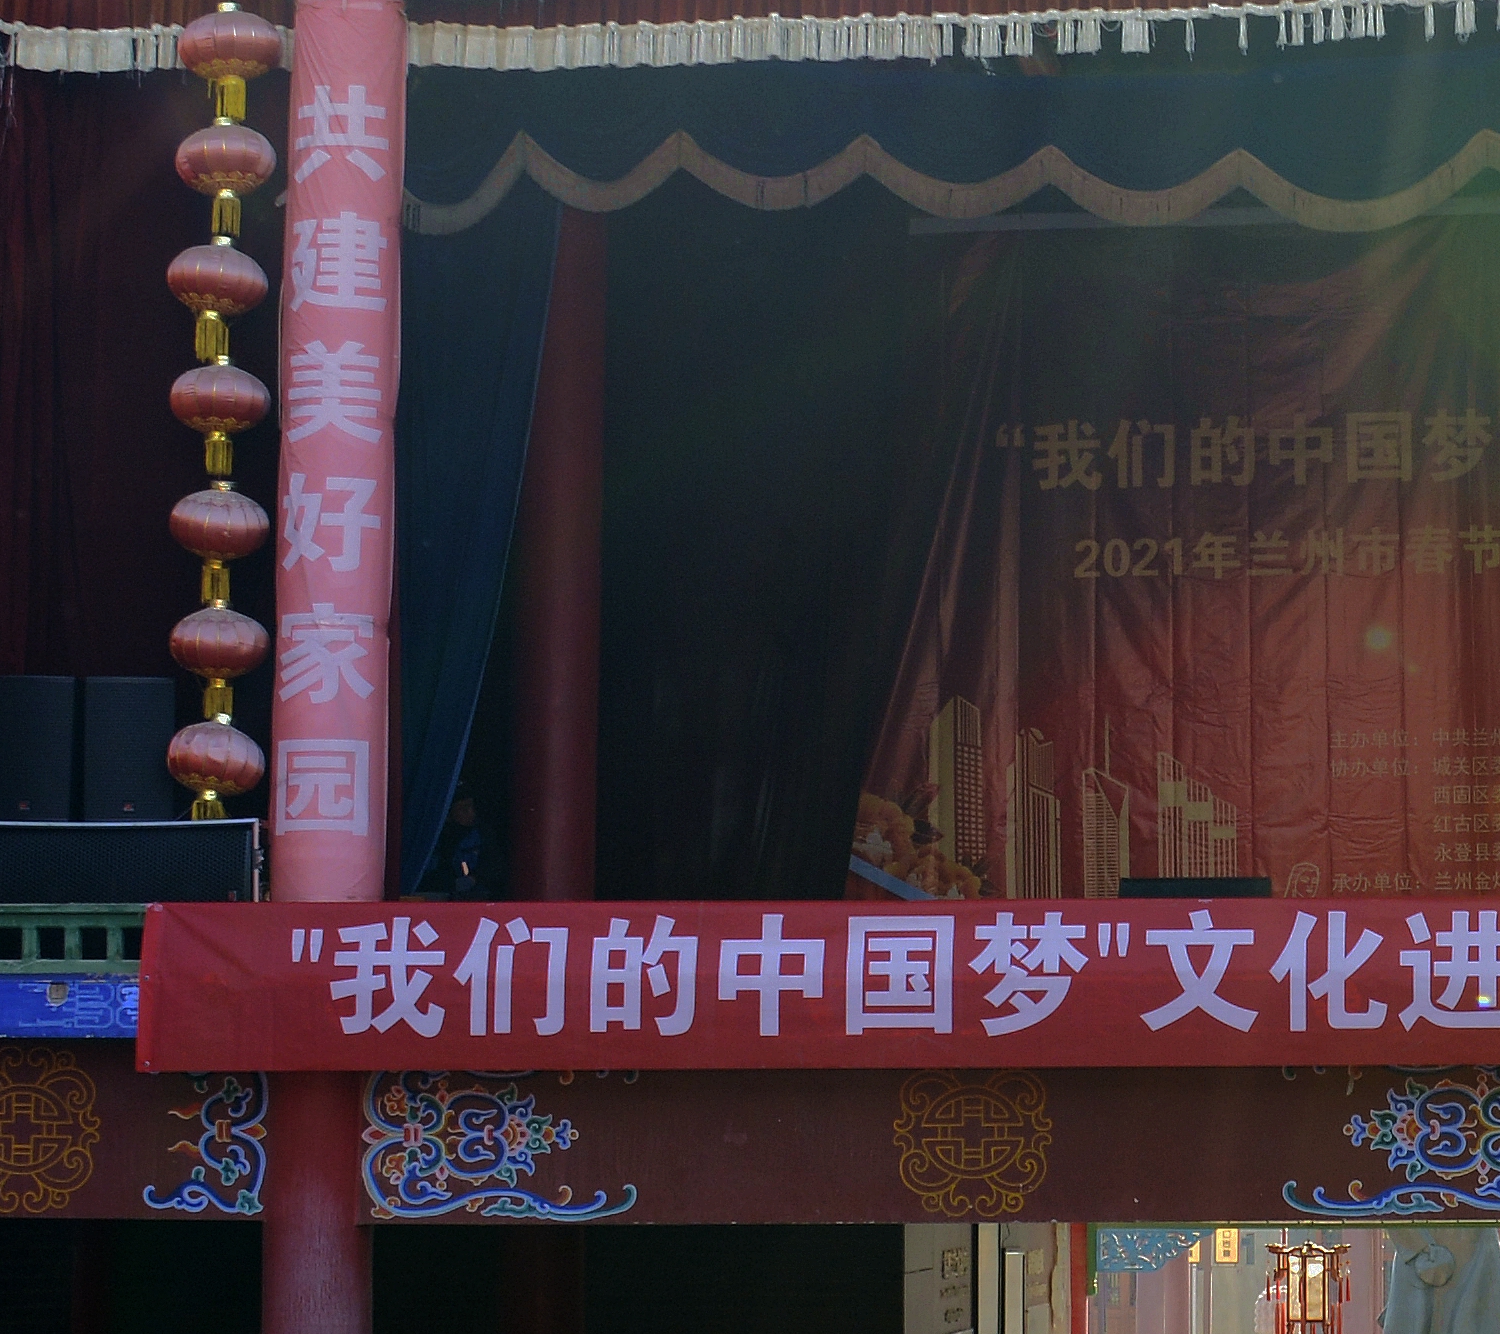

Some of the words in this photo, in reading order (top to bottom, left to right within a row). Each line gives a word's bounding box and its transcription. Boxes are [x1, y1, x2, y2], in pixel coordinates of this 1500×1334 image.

[275, 84, 390, 837] 共建美好家园
